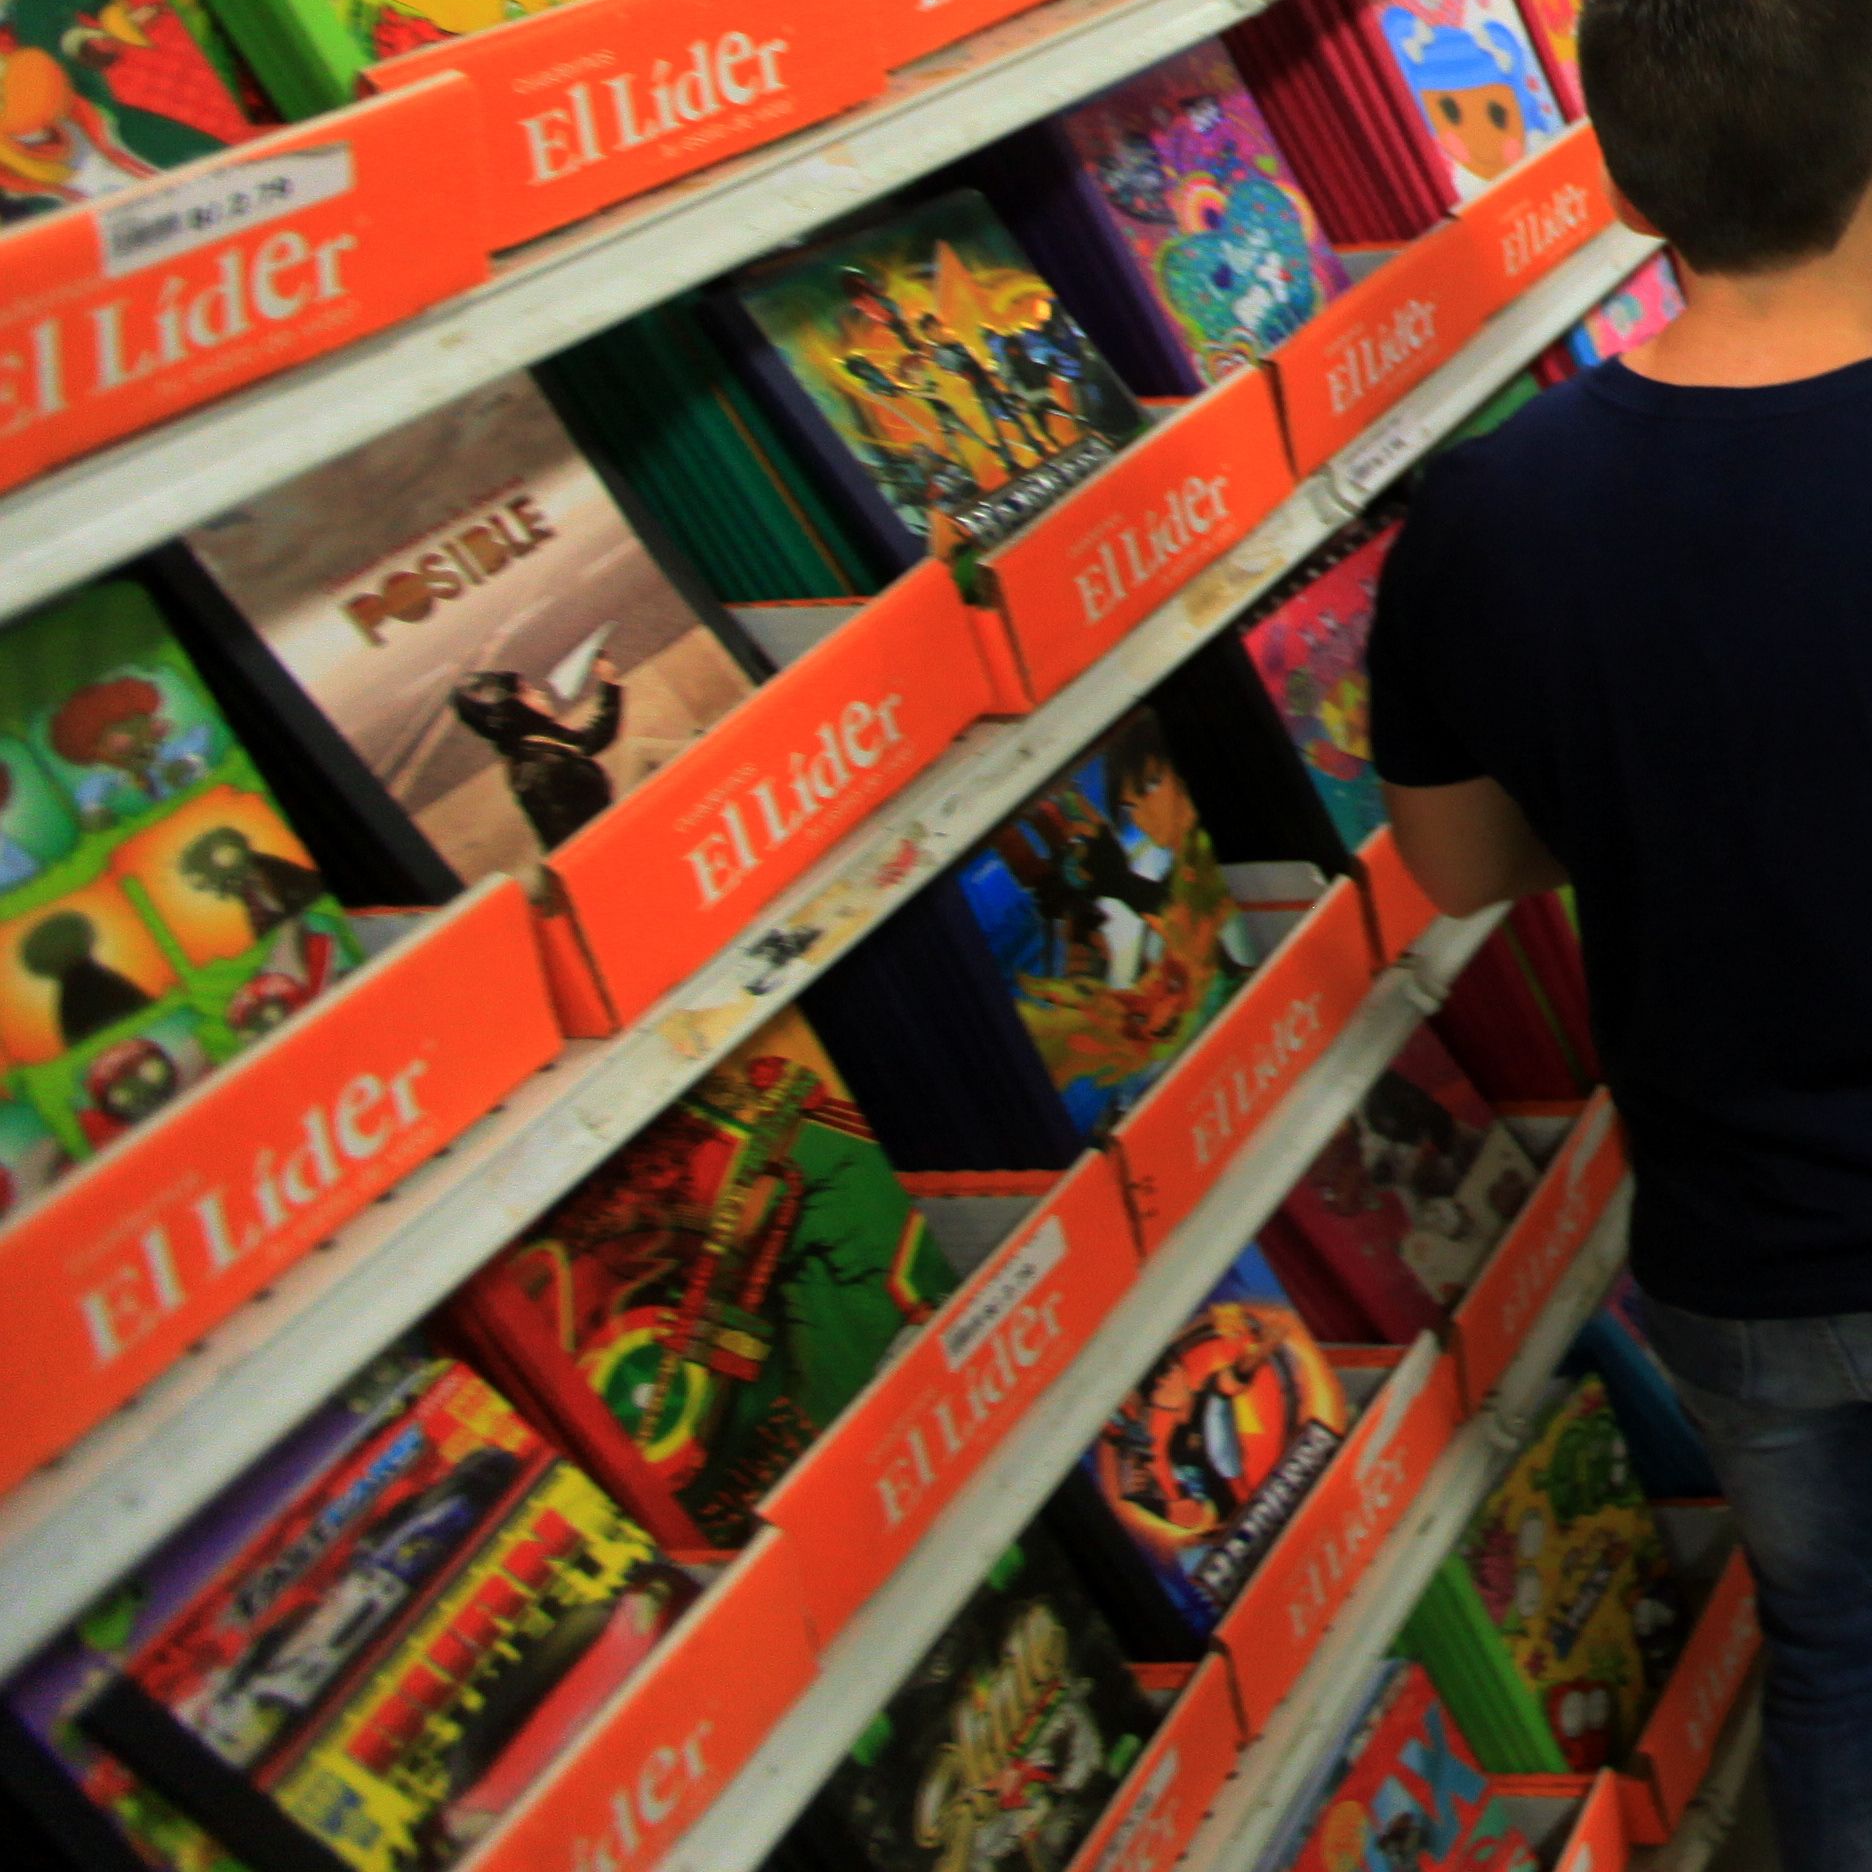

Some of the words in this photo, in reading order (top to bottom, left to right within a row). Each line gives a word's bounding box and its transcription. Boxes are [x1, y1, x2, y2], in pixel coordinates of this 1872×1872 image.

[521, 85, 598, 186] El
[605, 31, 790, 152] Líder
[90, 228, 358, 398] Líder
[337, 490, 556, 647] POSIBLE
[682, 809, 763, 910] El
[78, 1225, 188, 1366] El
